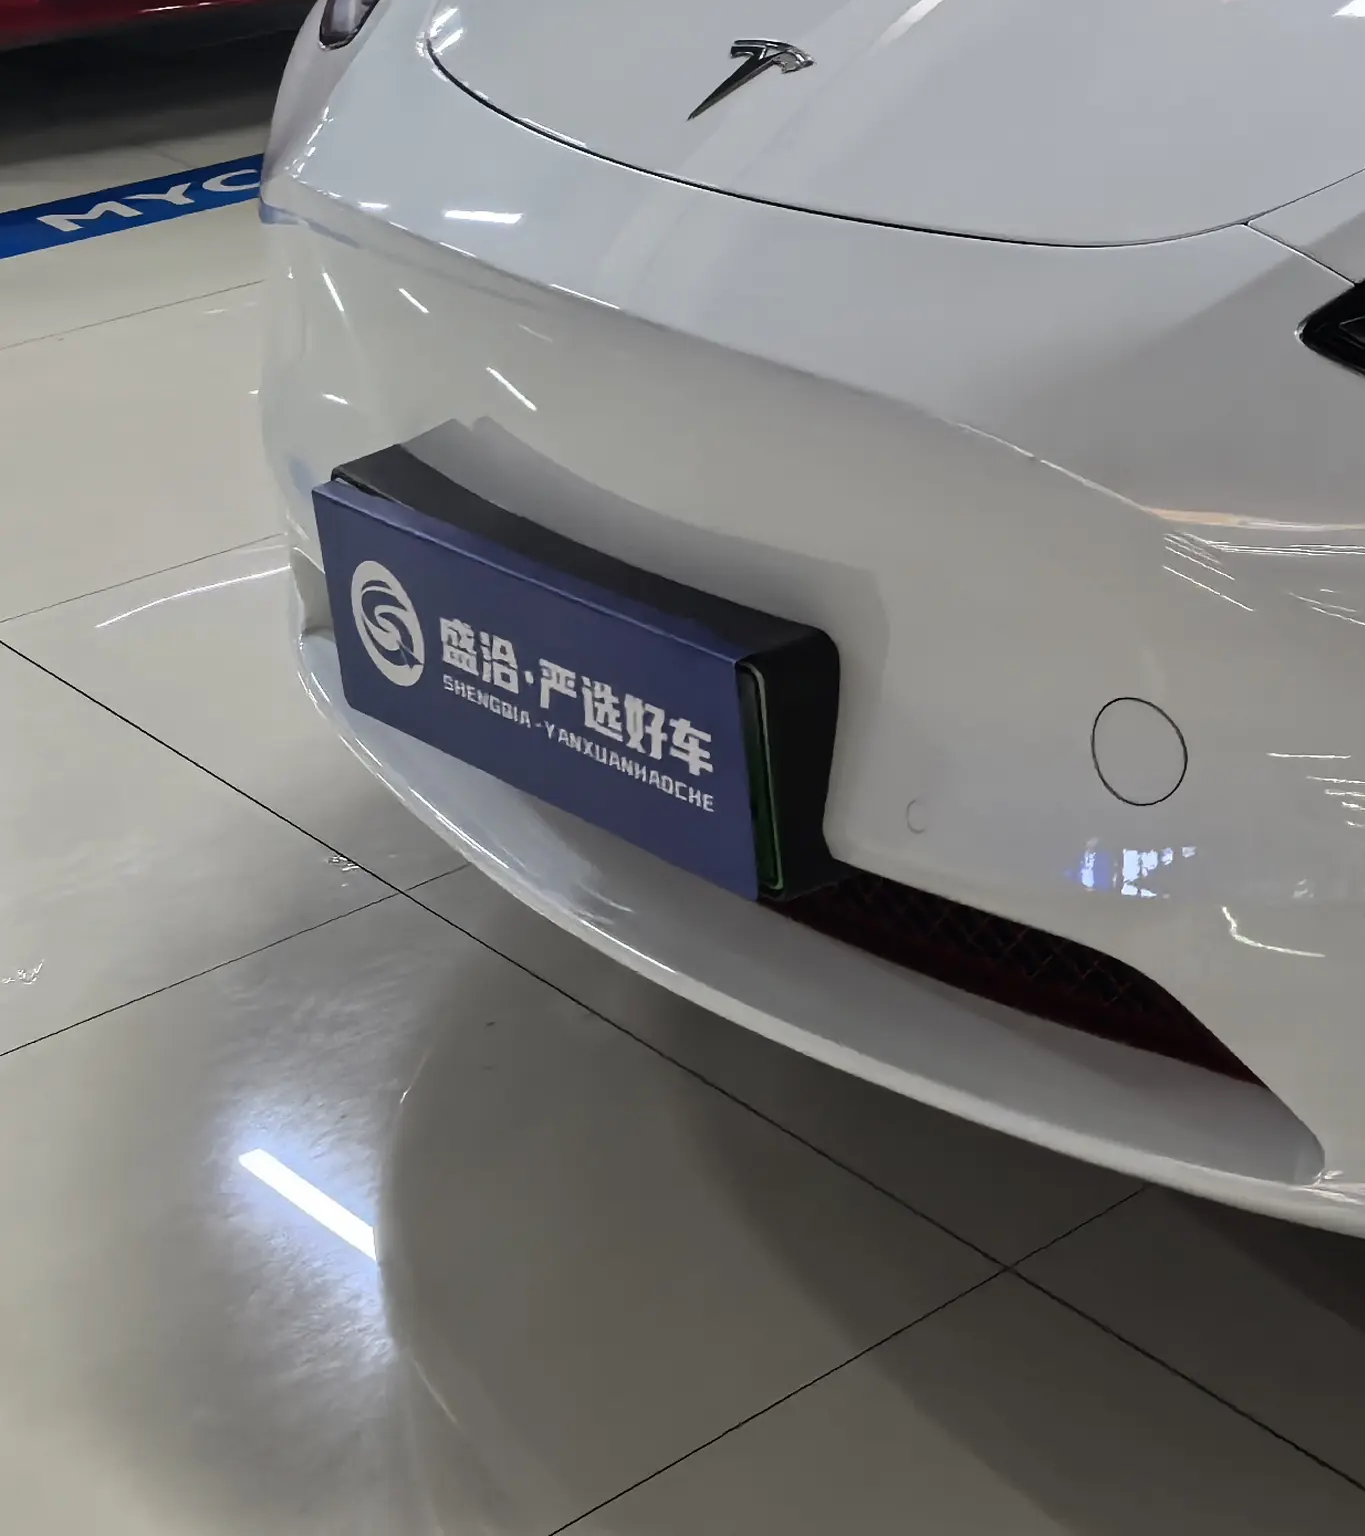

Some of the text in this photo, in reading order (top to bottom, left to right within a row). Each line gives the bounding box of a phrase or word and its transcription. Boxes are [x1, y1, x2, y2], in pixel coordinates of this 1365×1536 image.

[439, 617, 714, 776] 盛洽·严选好车
